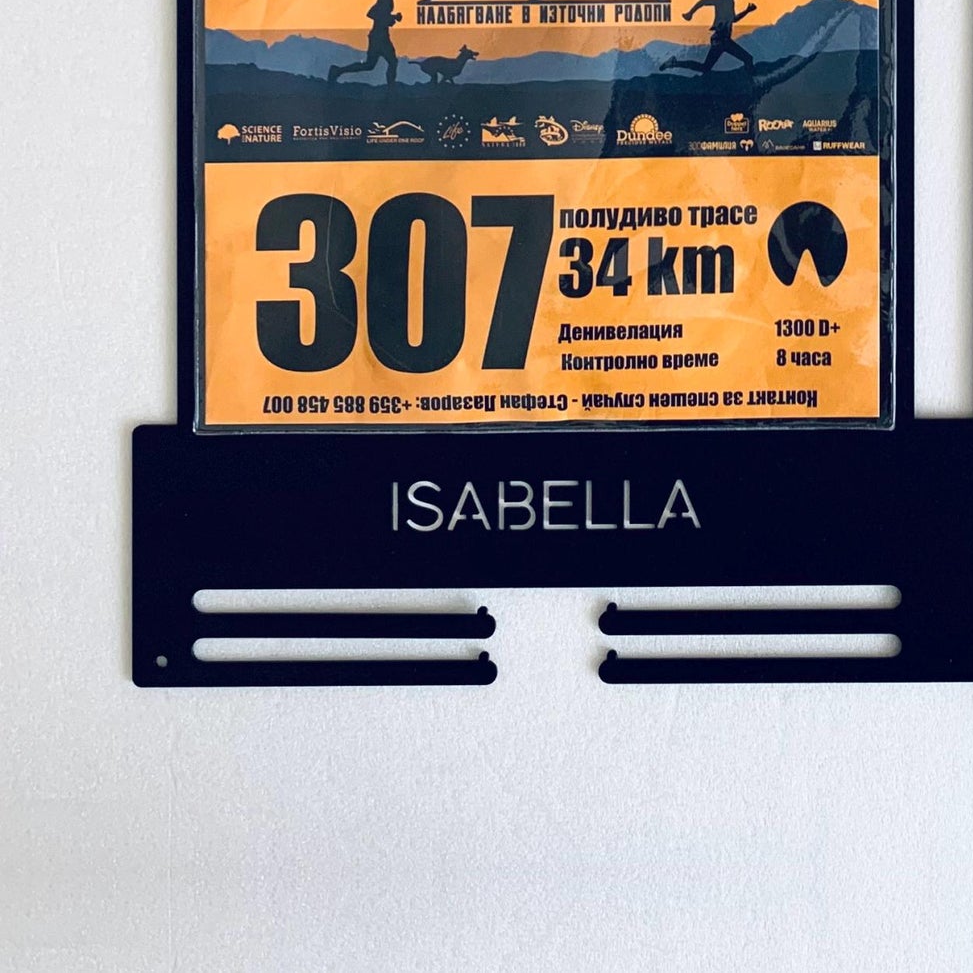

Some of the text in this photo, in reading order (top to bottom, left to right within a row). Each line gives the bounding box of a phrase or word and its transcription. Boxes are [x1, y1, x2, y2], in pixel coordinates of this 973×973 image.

[416, 5, 514, 25] НАДБЯГВАНЕ
[539, 3, 606, 24] ИЗТОЧНИ
[614, 3, 672, 23] РОДОПИ
[241, 125, 283, 135] SCIENCE
[292, 125, 363, 138] FortisVisio
[569, 119, 604, 134] Disney
[616, 129, 672, 142] Dundee
[244, 135, 283, 143] NATURE
[823, 141, 866, 150] RUFFWEAR
[559, 205, 758, 230] полудиво трасе
[558, 236, 735, 299] 34 km
[256, 193, 555, 373] 307
[558, 323, 684, 344] Денивелация
[775, 319, 841, 337] 1300 D+
[561, 352, 719, 372] Контролно време
[776, 349, 832, 367] 8 часа
[262, 396, 294, 414] 007
[297, 396, 330, 413] 458
[333, 396, 365, 414] 885
[369, 396, 413, 414] +359
[499, 394, 568, 411] Стефан
[581, 392, 646, 412] случай
[649, 392, 719, 408] спешен
[722, 391, 743, 407] за
[746, 390, 818, 408] Контакт
[392, 479, 701, 532] ISABELLA
